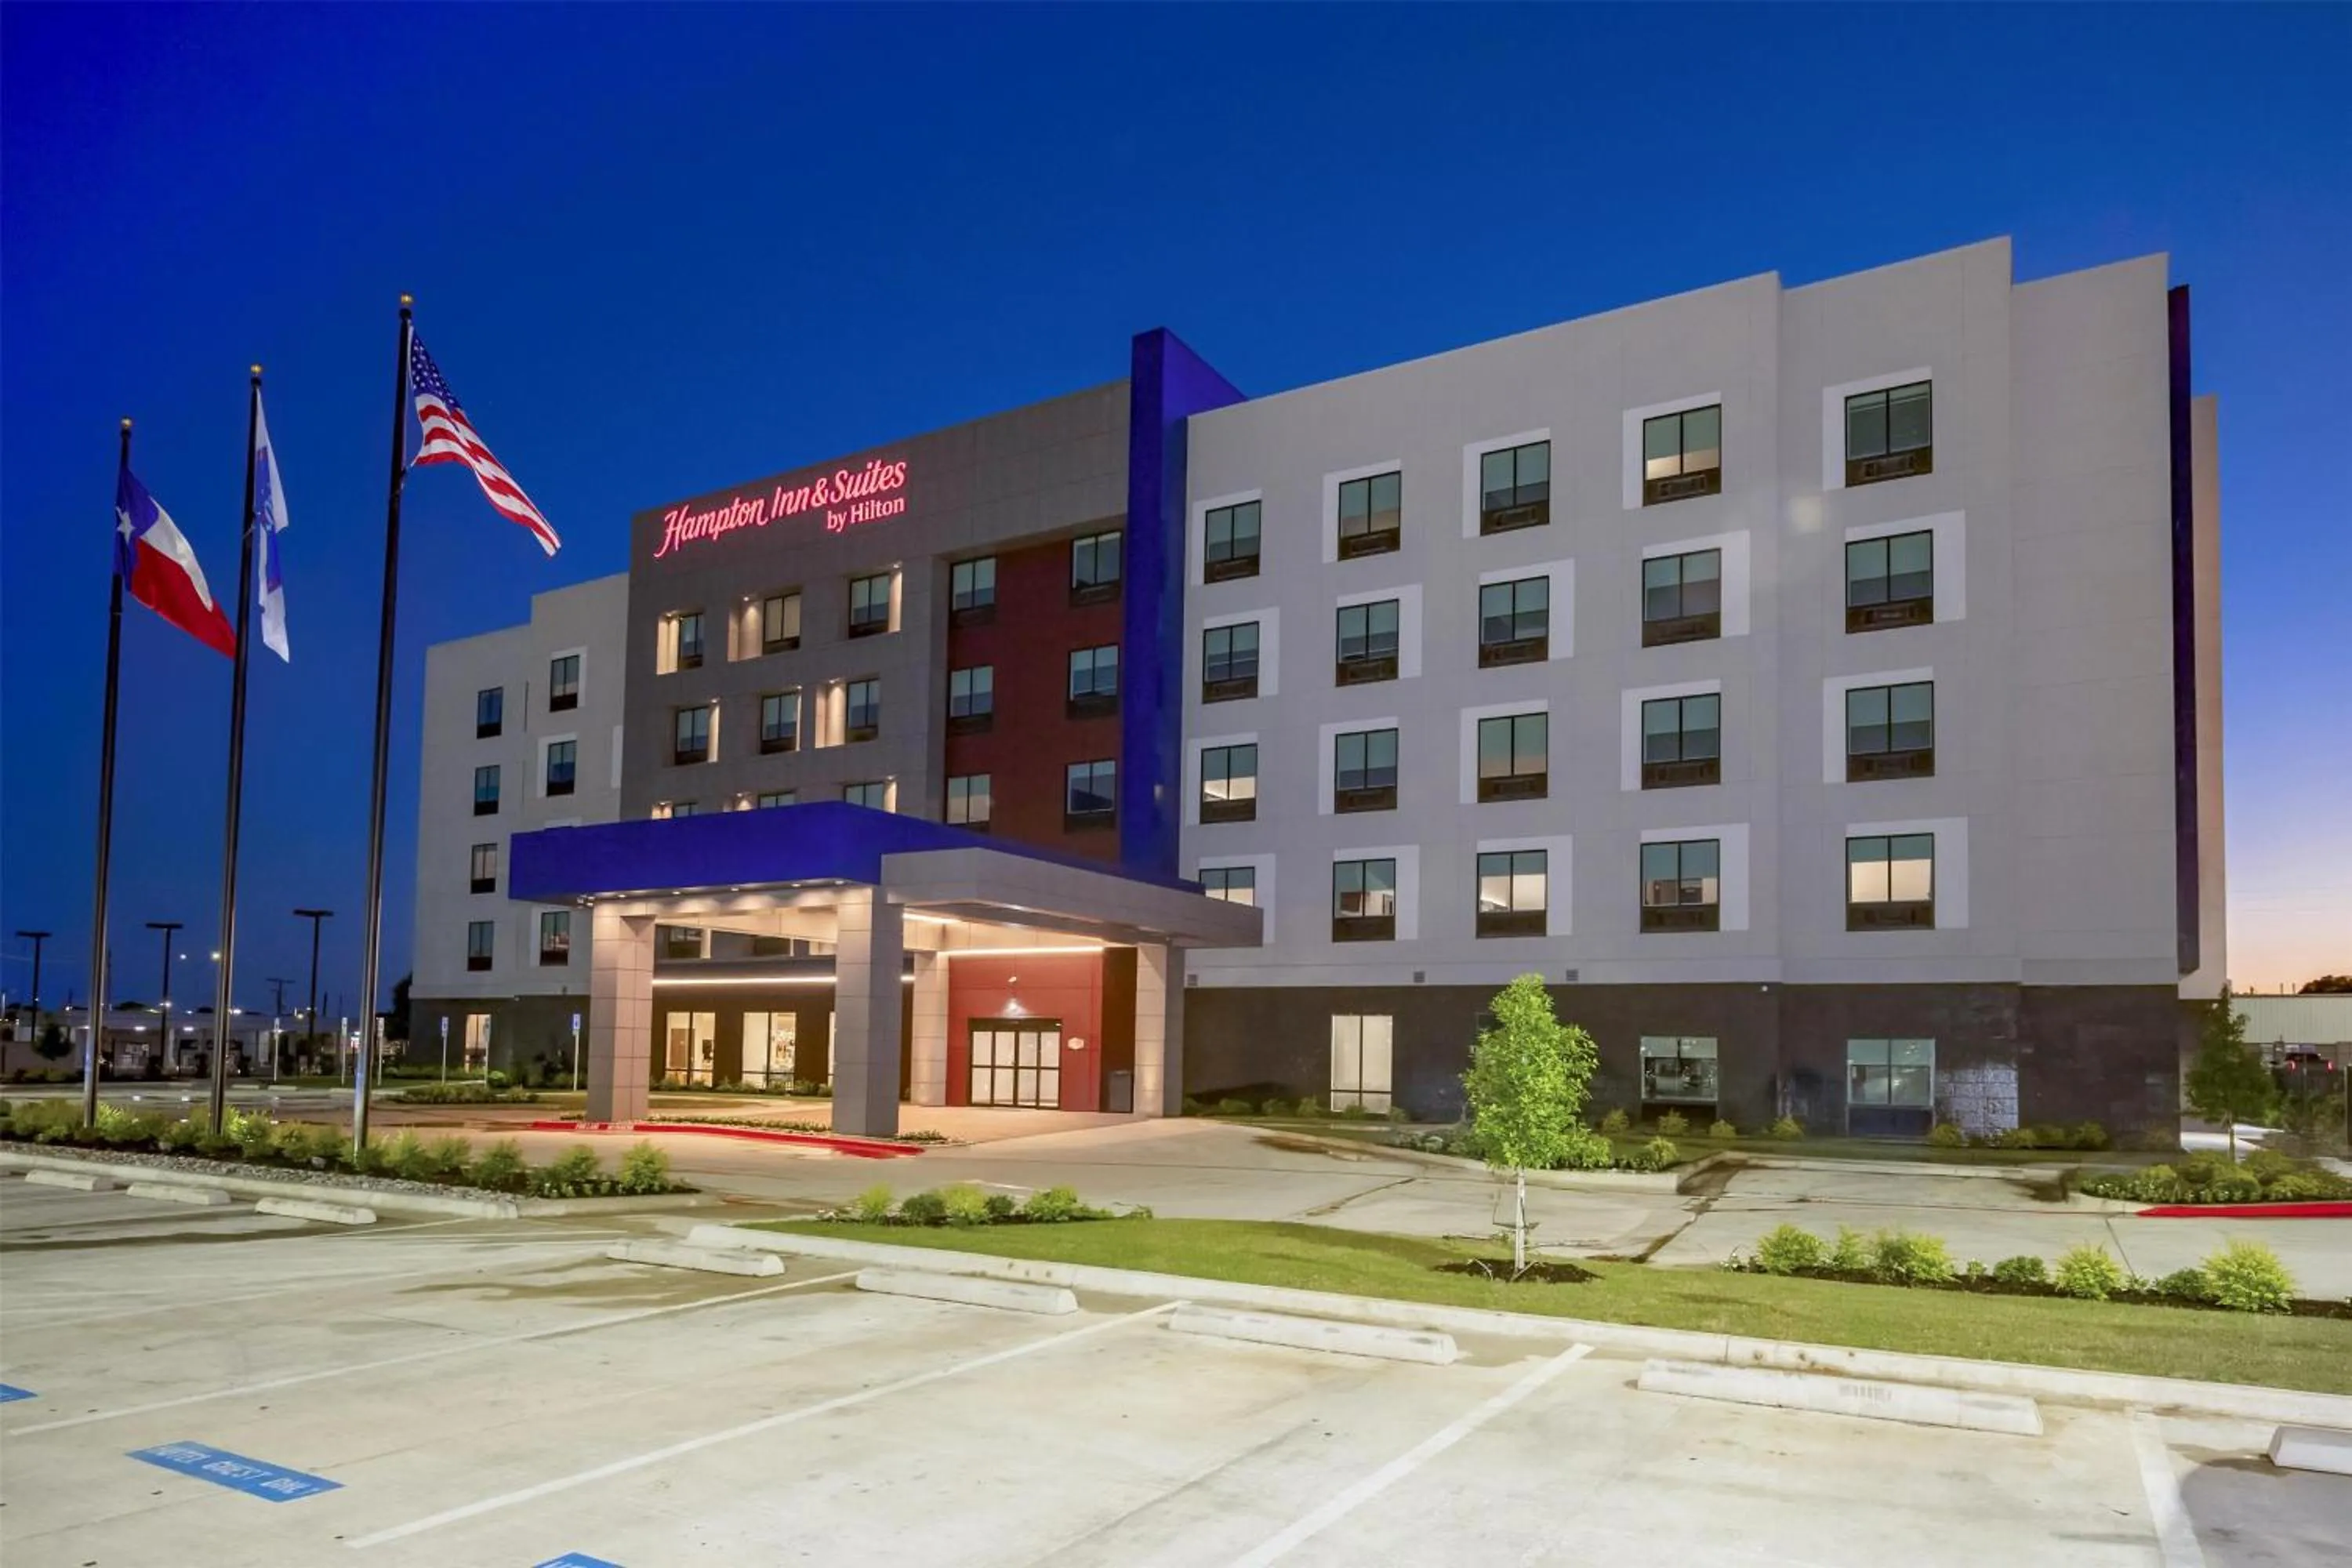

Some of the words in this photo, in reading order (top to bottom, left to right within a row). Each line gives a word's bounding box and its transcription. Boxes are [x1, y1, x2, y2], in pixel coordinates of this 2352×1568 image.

[653, 504, 768, 557] Hampton
[827, 510, 848, 532] by
[851, 498, 905, 524] Hilton
